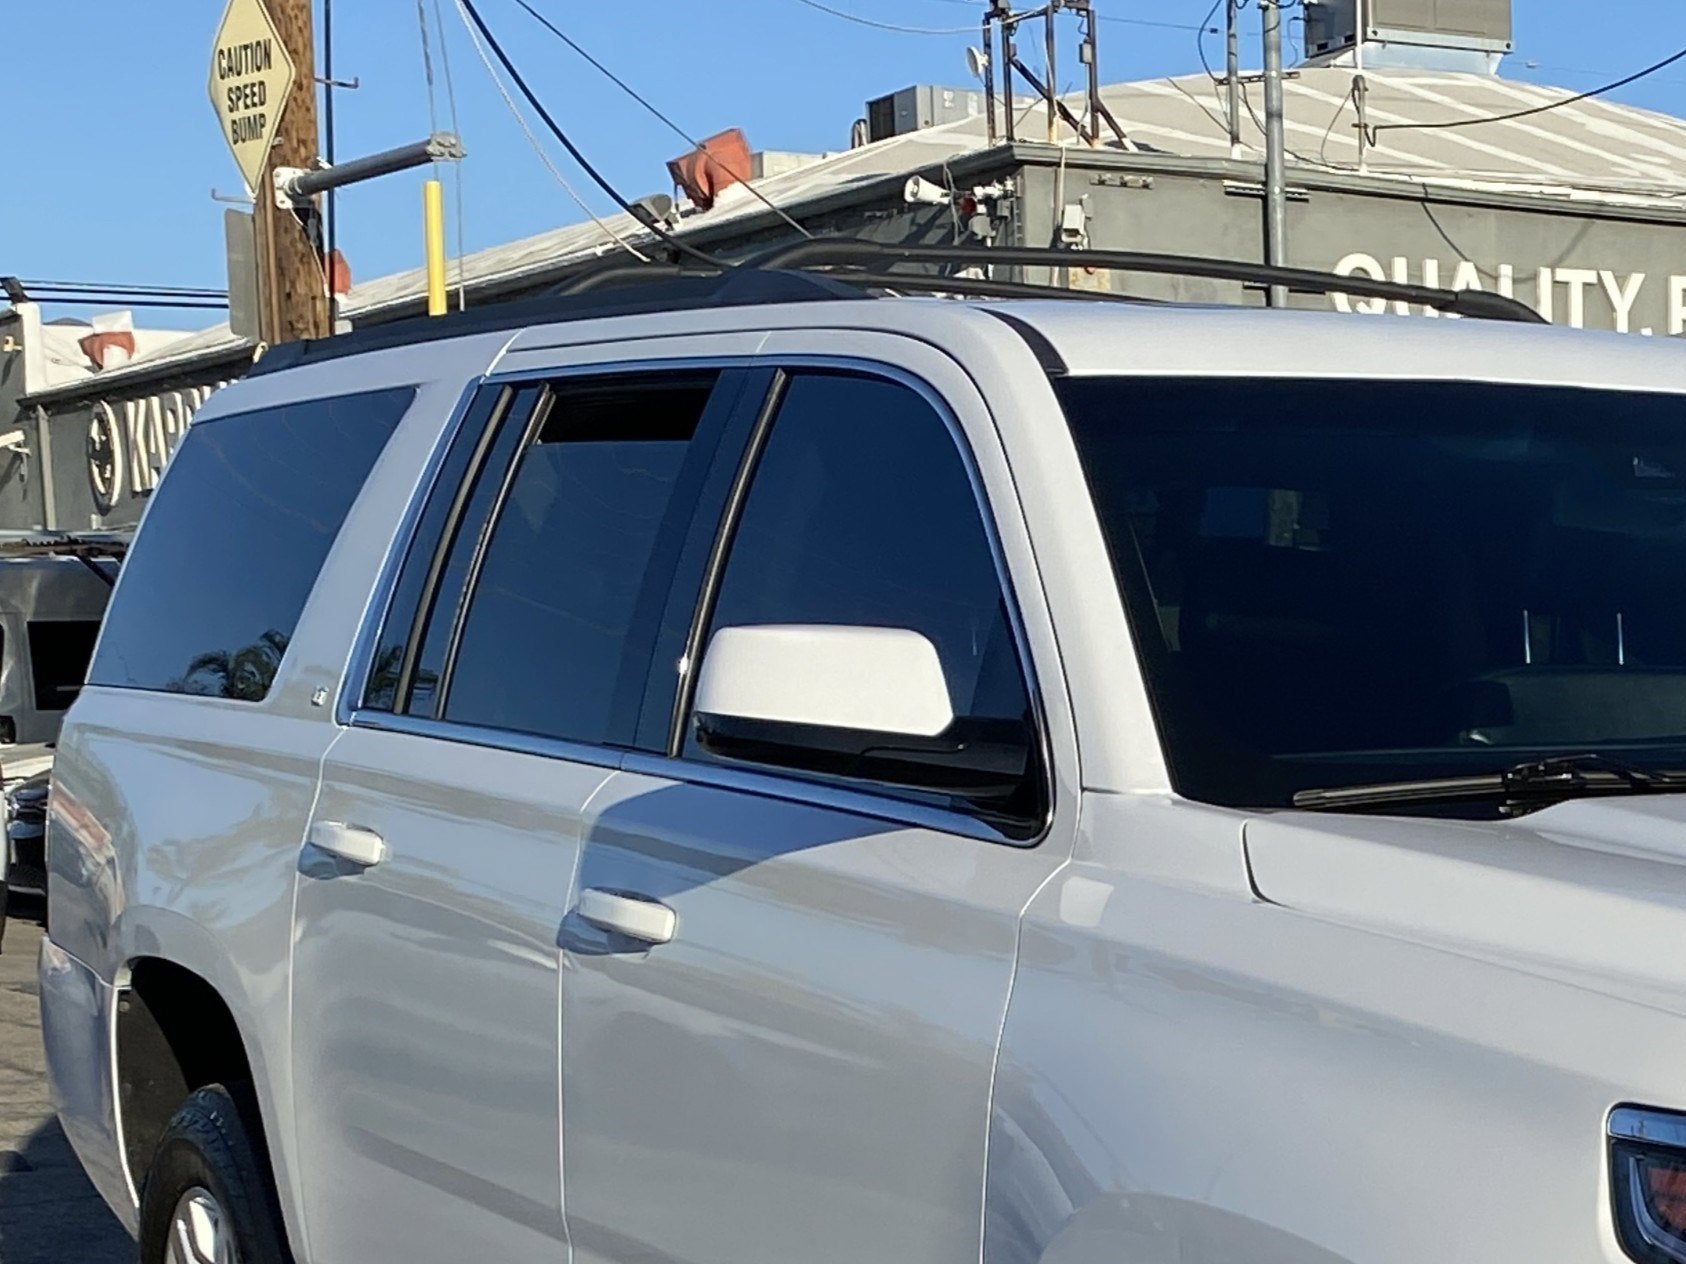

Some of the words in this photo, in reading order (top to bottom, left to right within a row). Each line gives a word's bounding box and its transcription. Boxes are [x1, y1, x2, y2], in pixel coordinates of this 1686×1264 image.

[218, 39, 272, 80] CAUTION
[227, 80, 267, 113] SPEED
[231, 113, 266, 145] BUMP
